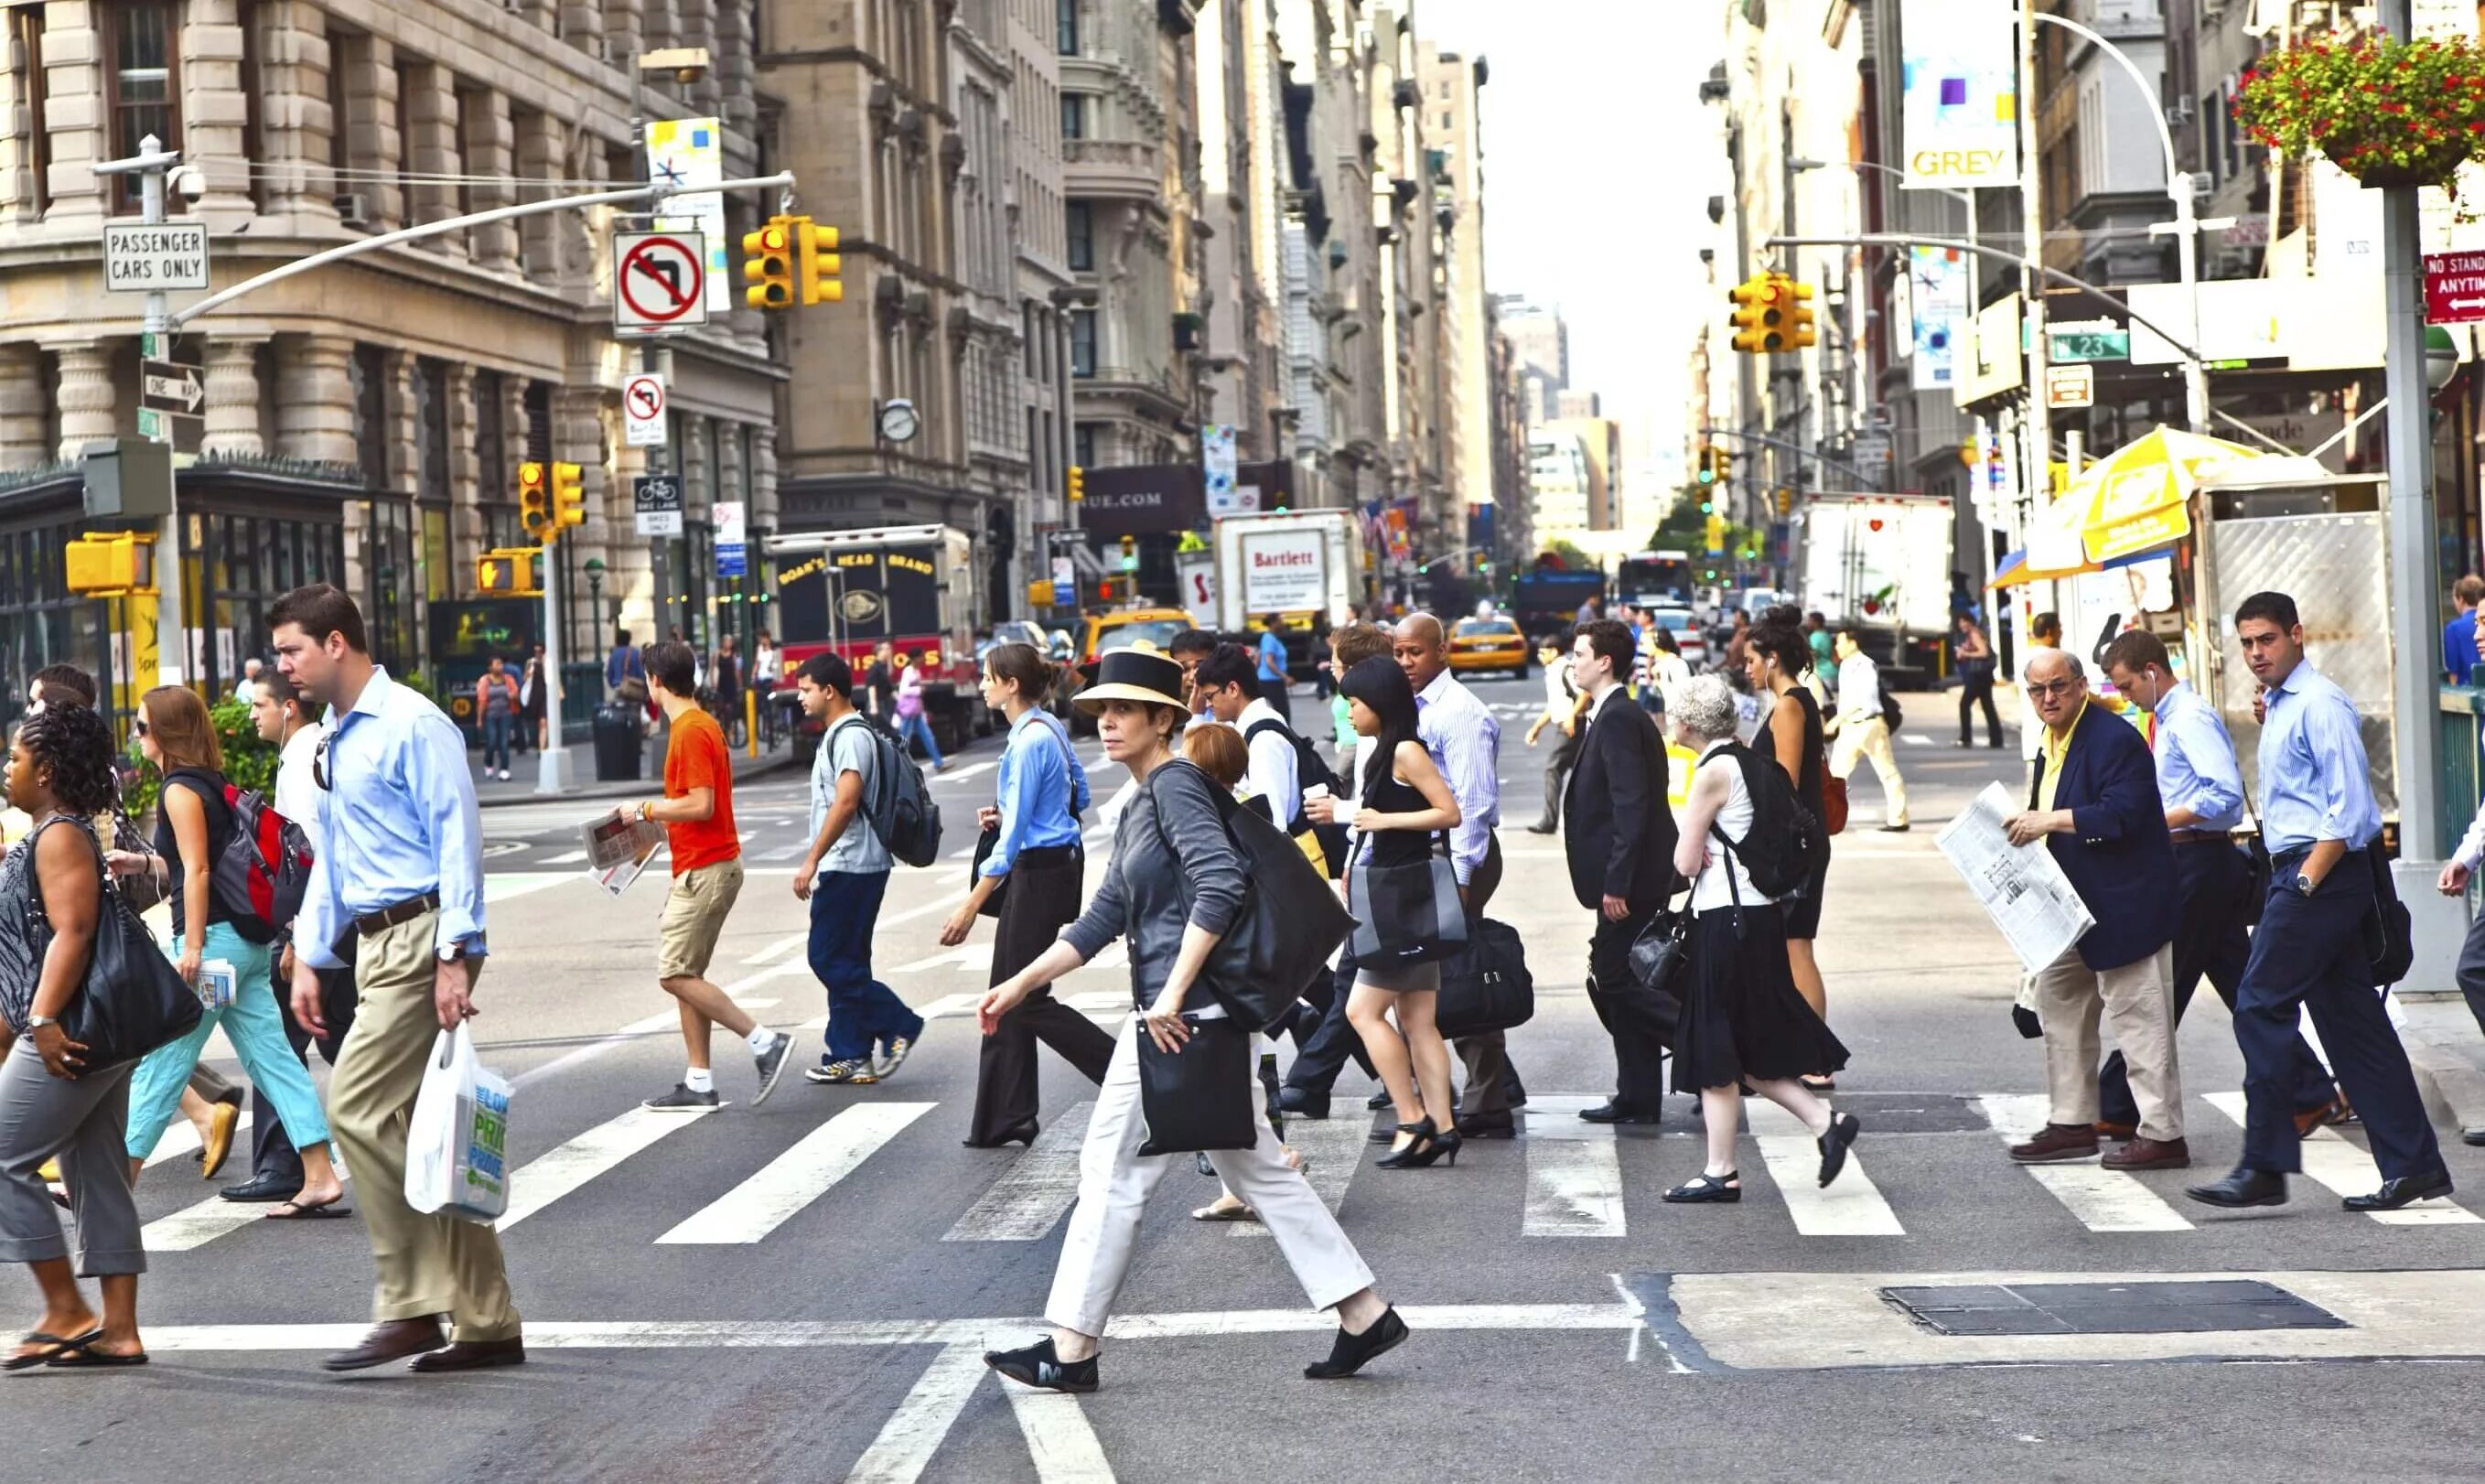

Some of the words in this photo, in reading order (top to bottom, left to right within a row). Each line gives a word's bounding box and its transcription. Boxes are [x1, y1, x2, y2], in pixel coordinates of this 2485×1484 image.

[1913, 150, 2004, 175] GREY
[111, 232, 200, 253] PASSENGER
[112, 260, 152, 279] CARS
[163, 259, 200, 278] ONLY
[2429, 260, 2444, 274] NO
[2079, 336, 2104, 356] 23
[150, 378, 167, 395] ONE
[181, 381, 199, 397] WAY
[656, 500, 679, 510] LANE
[1253, 550, 1313, 567] Bartlett
[779, 557, 826, 586] BOAR'S
[837, 554, 874, 566] HEAD
[888, 554, 933, 575] BRAND
